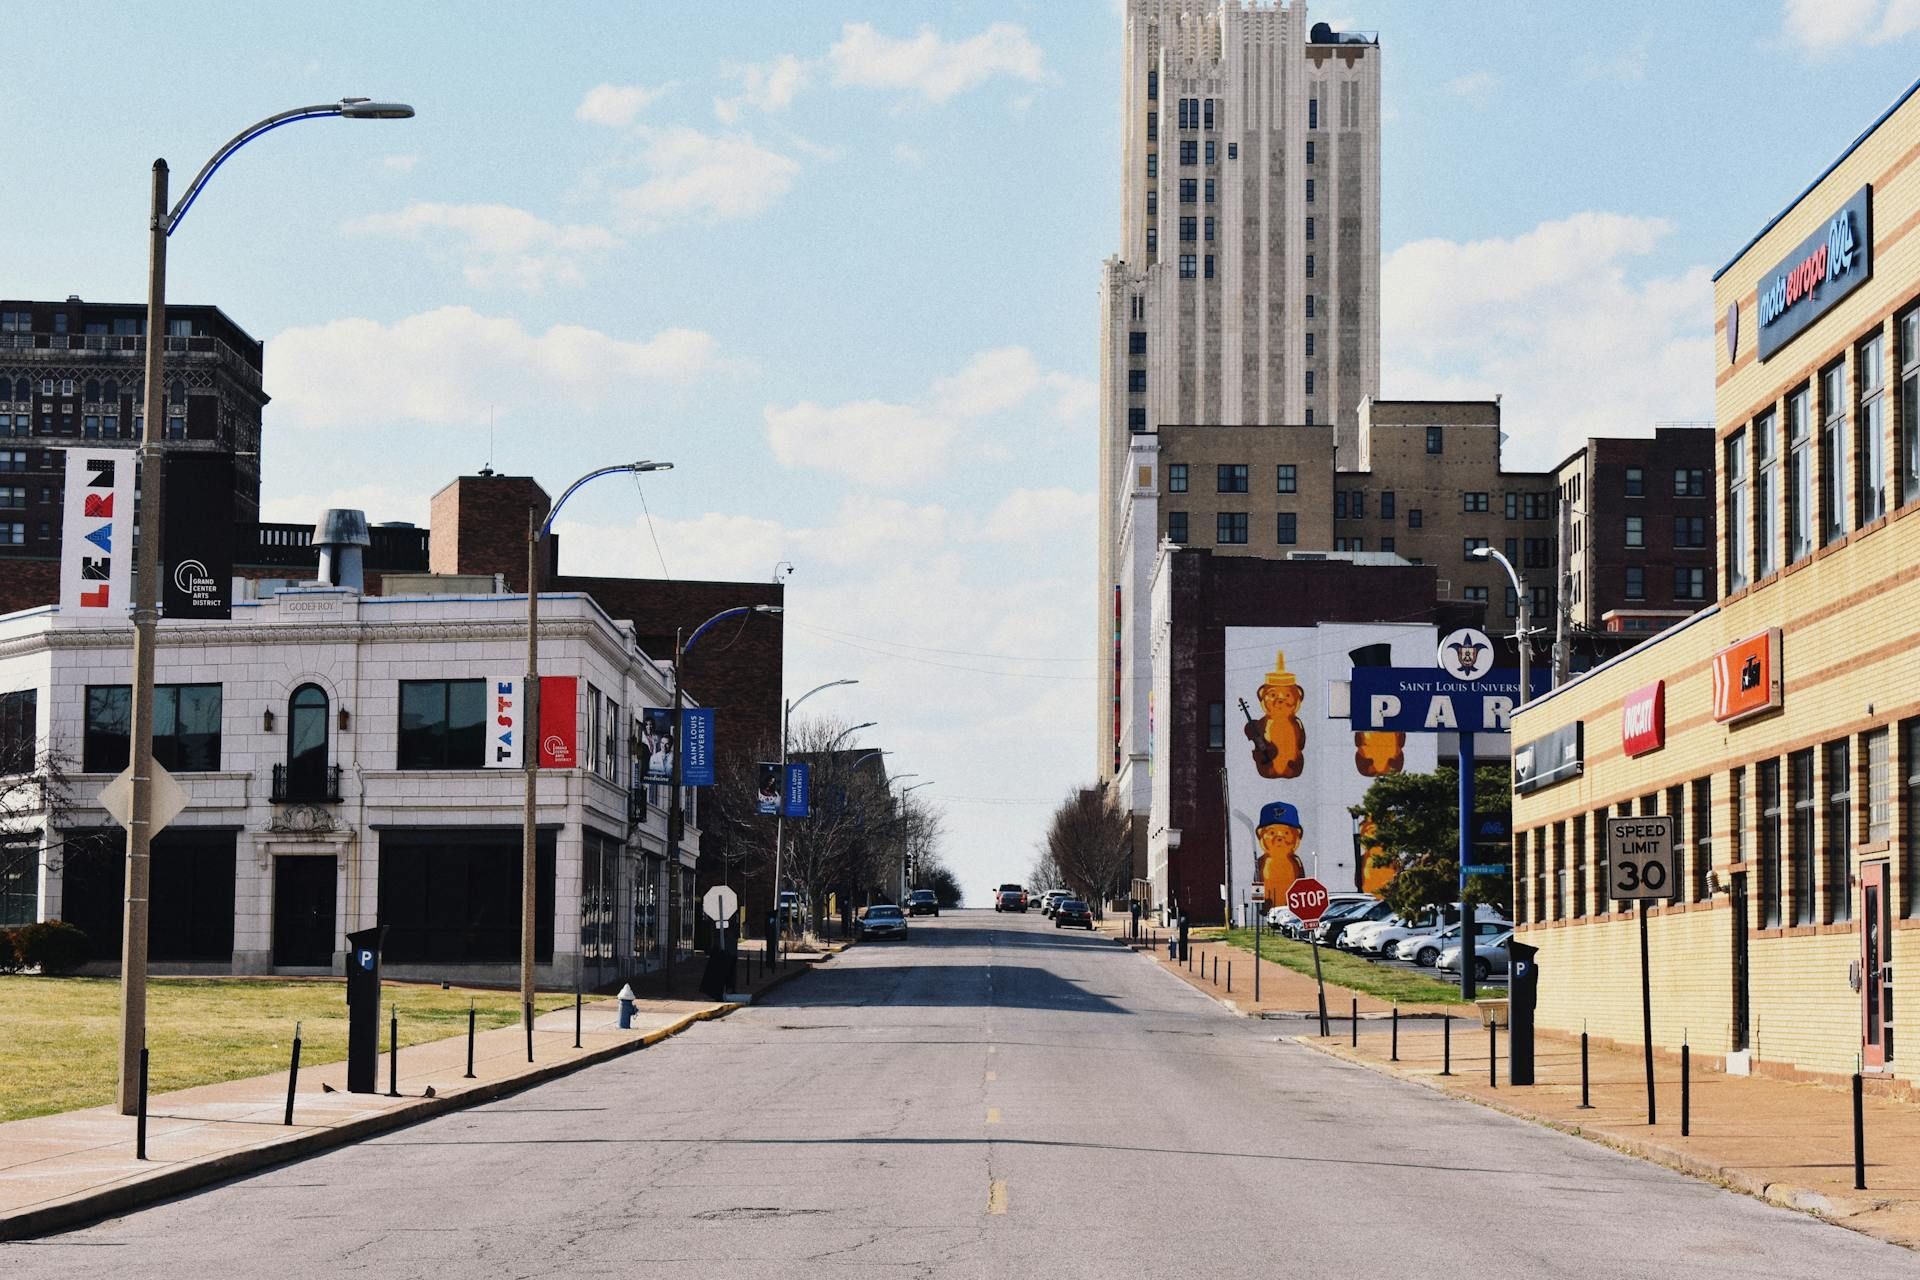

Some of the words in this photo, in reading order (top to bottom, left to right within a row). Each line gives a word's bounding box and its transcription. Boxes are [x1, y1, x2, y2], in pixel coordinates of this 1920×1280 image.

[80, 459, 115, 608] LEARN
[192, 599, 221, 607] DISTRICT
[289, 602, 334, 612] GODEFROY
[1400, 680, 1431, 692] SAINT
[1436, 681, 1467, 692] LOUIS
[1471, 682, 1536, 693] UNIVERSIY
[497, 682, 512, 762] TASTE
[690, 715, 698, 740] LOUIS
[1624, 698, 1653, 741] DUCATI
[690, 742, 698, 766] SAINT
[1615, 825, 1666, 838] SPEED
[1622, 841, 1660, 854] LIMIT
[1617, 860, 1666, 891] 30
[1289, 890, 1326, 909] STOP
[361, 951, 372, 967] P
[1516, 962, 1525, 976] P
